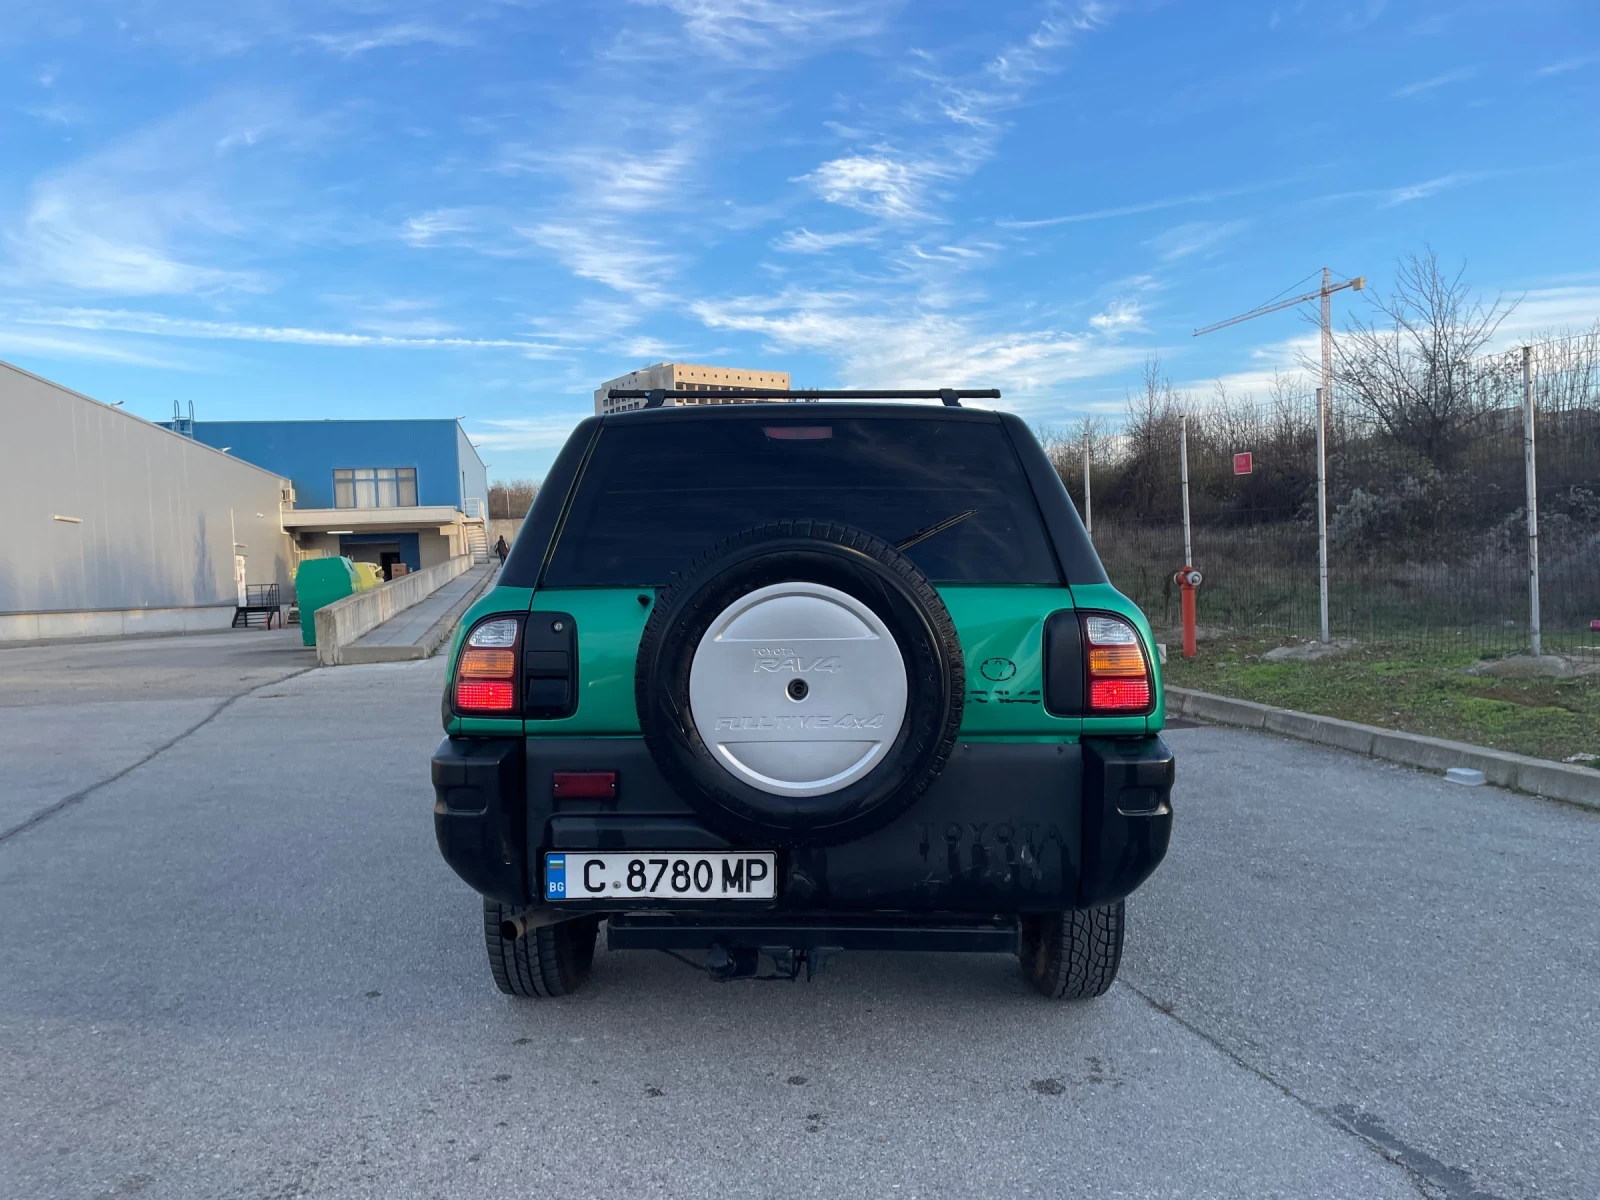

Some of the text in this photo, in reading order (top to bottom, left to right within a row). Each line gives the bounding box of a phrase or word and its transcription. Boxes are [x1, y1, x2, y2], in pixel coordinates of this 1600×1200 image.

[752, 648, 795, 656] TOYOTA
[753, 656, 841, 673] RAV4
[833, 713, 884, 729] 4x4
[913, 821, 1064, 844] TOYOTA
[583, 859, 768, 893] C 8780 MP
[549, 881, 564, 893] BG
